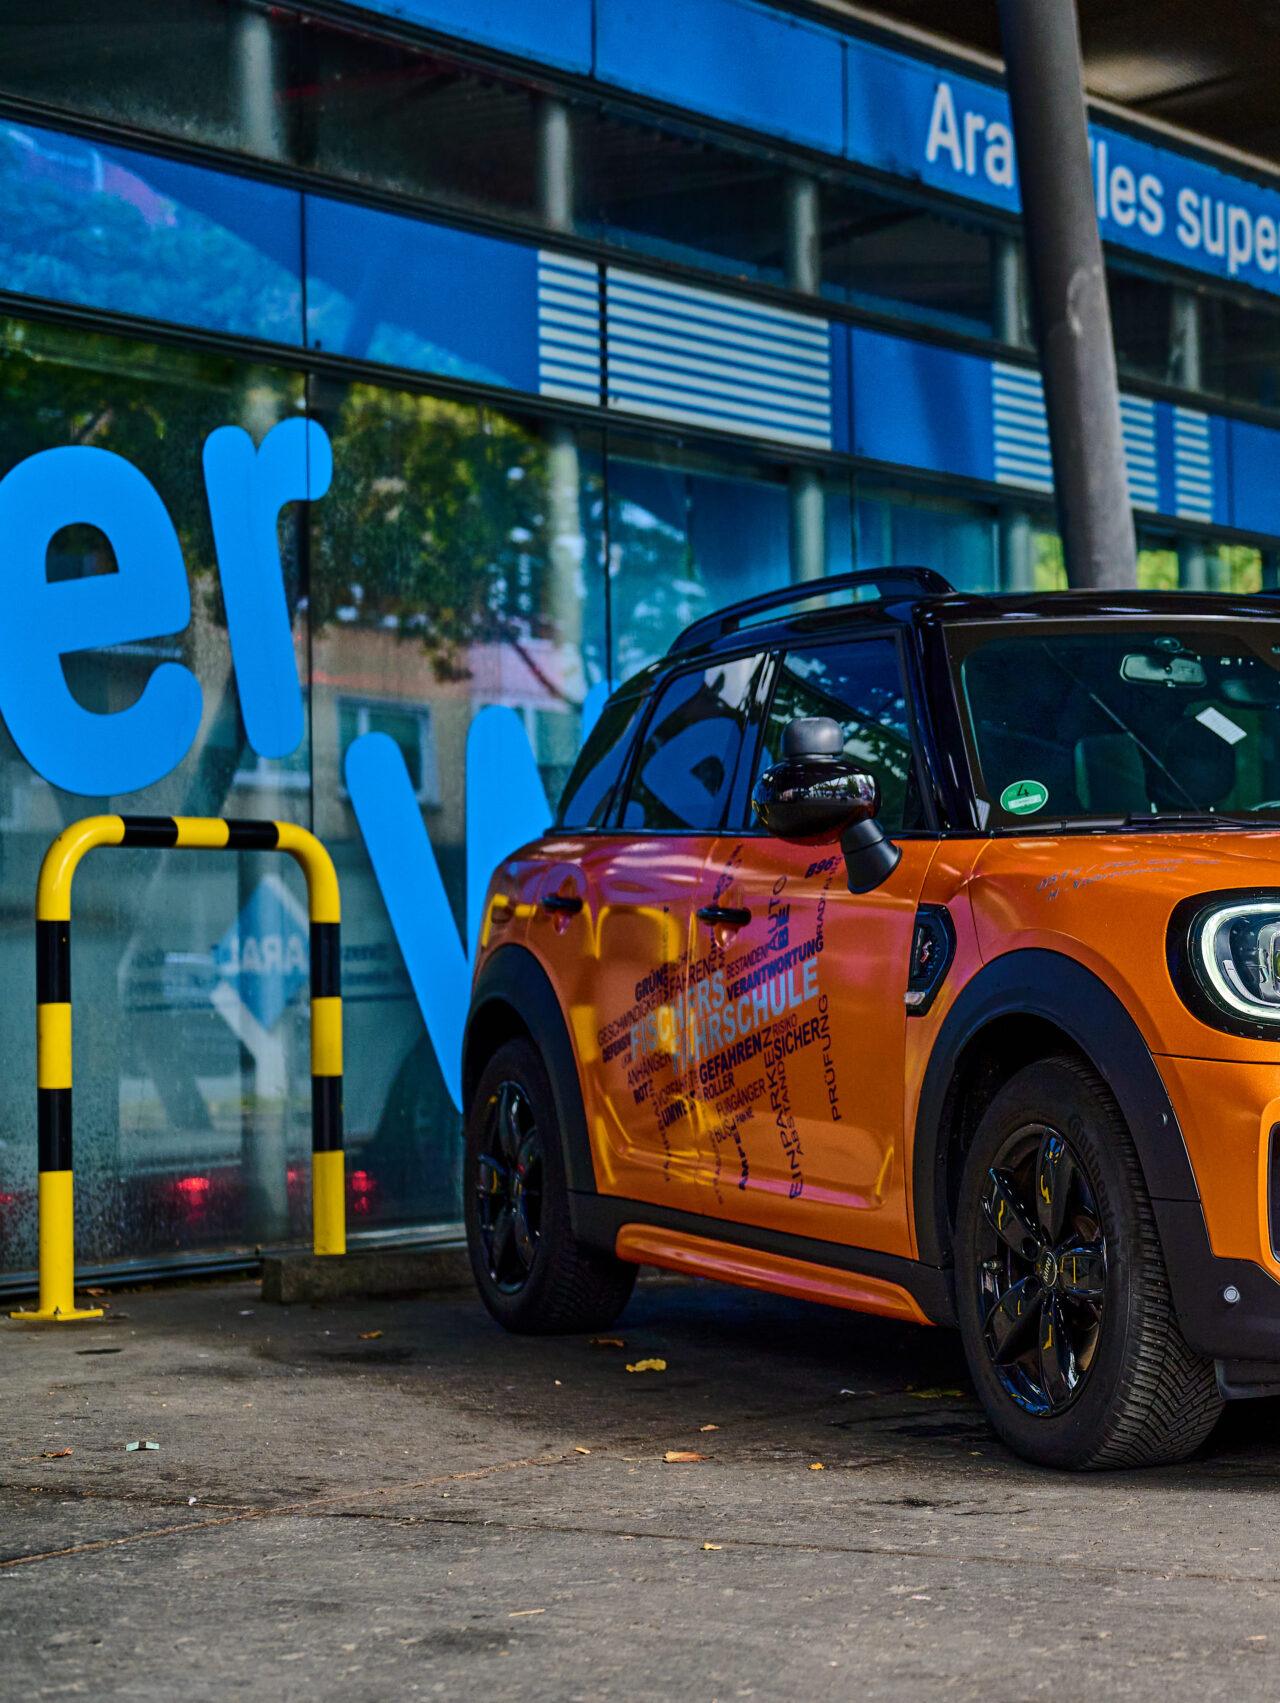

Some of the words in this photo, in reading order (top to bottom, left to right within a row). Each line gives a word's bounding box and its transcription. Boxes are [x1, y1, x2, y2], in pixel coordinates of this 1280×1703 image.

[926, 83, 1017, 188] Ara
[1087, 134, 1165, 237] les
[727, 937, 823, 1001] VERANTWORTUNG
[699, 1033, 762, 1085] GEFAHREN
[774, 1017, 820, 1060] SICHER
[818, 994, 842, 1122] PRÜFUNG
[703, 1072, 735, 1101] ROLLER
